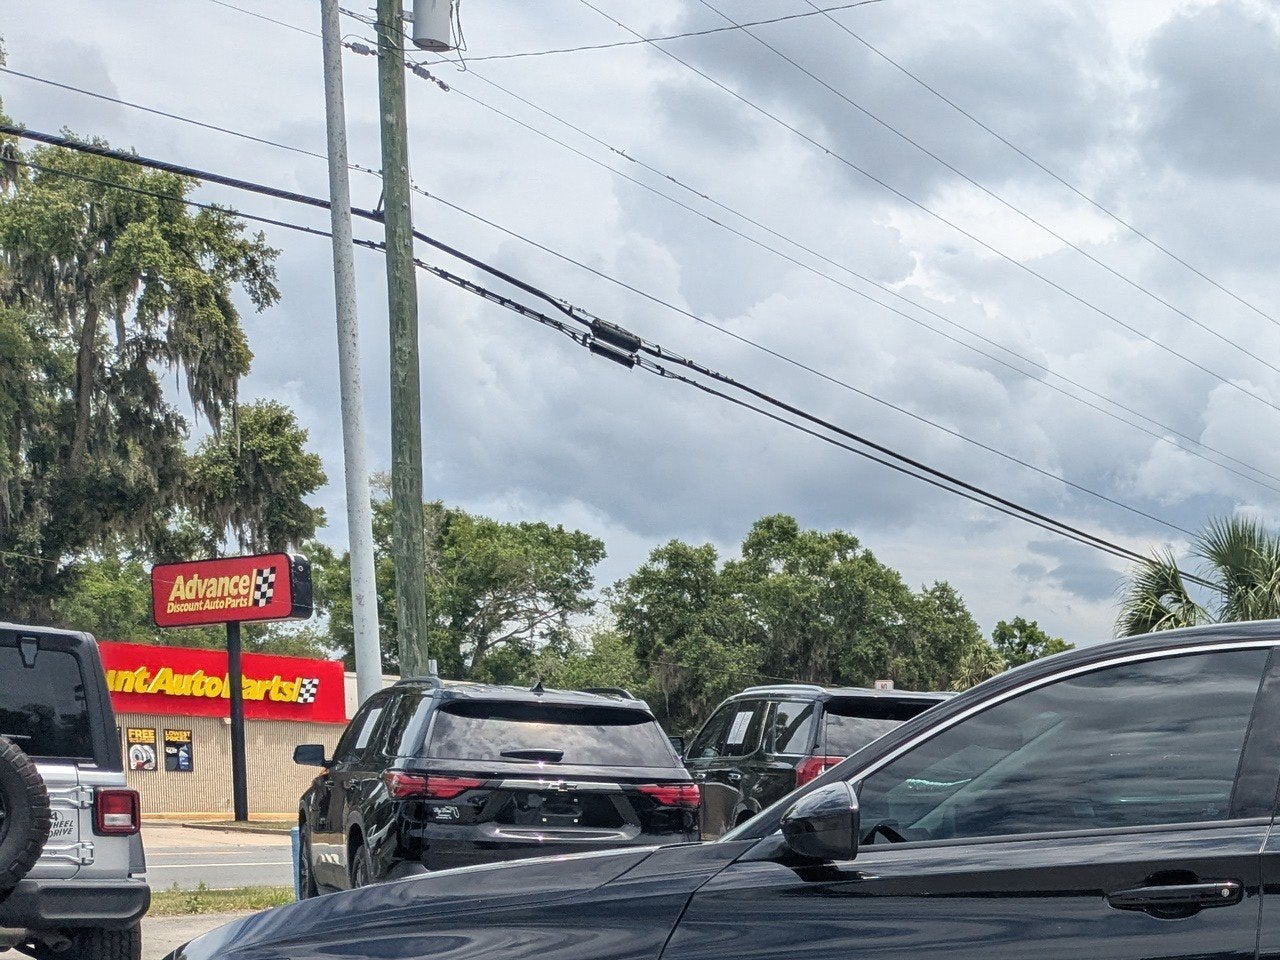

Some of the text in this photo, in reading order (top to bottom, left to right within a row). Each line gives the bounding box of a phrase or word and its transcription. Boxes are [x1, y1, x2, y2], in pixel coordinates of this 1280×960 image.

[168, 573, 250, 602] Advance
[167, 596, 248, 613] Discount Auto Parts
[147, 667, 222, 697] Auto
[128, 729, 155, 738] FREE
